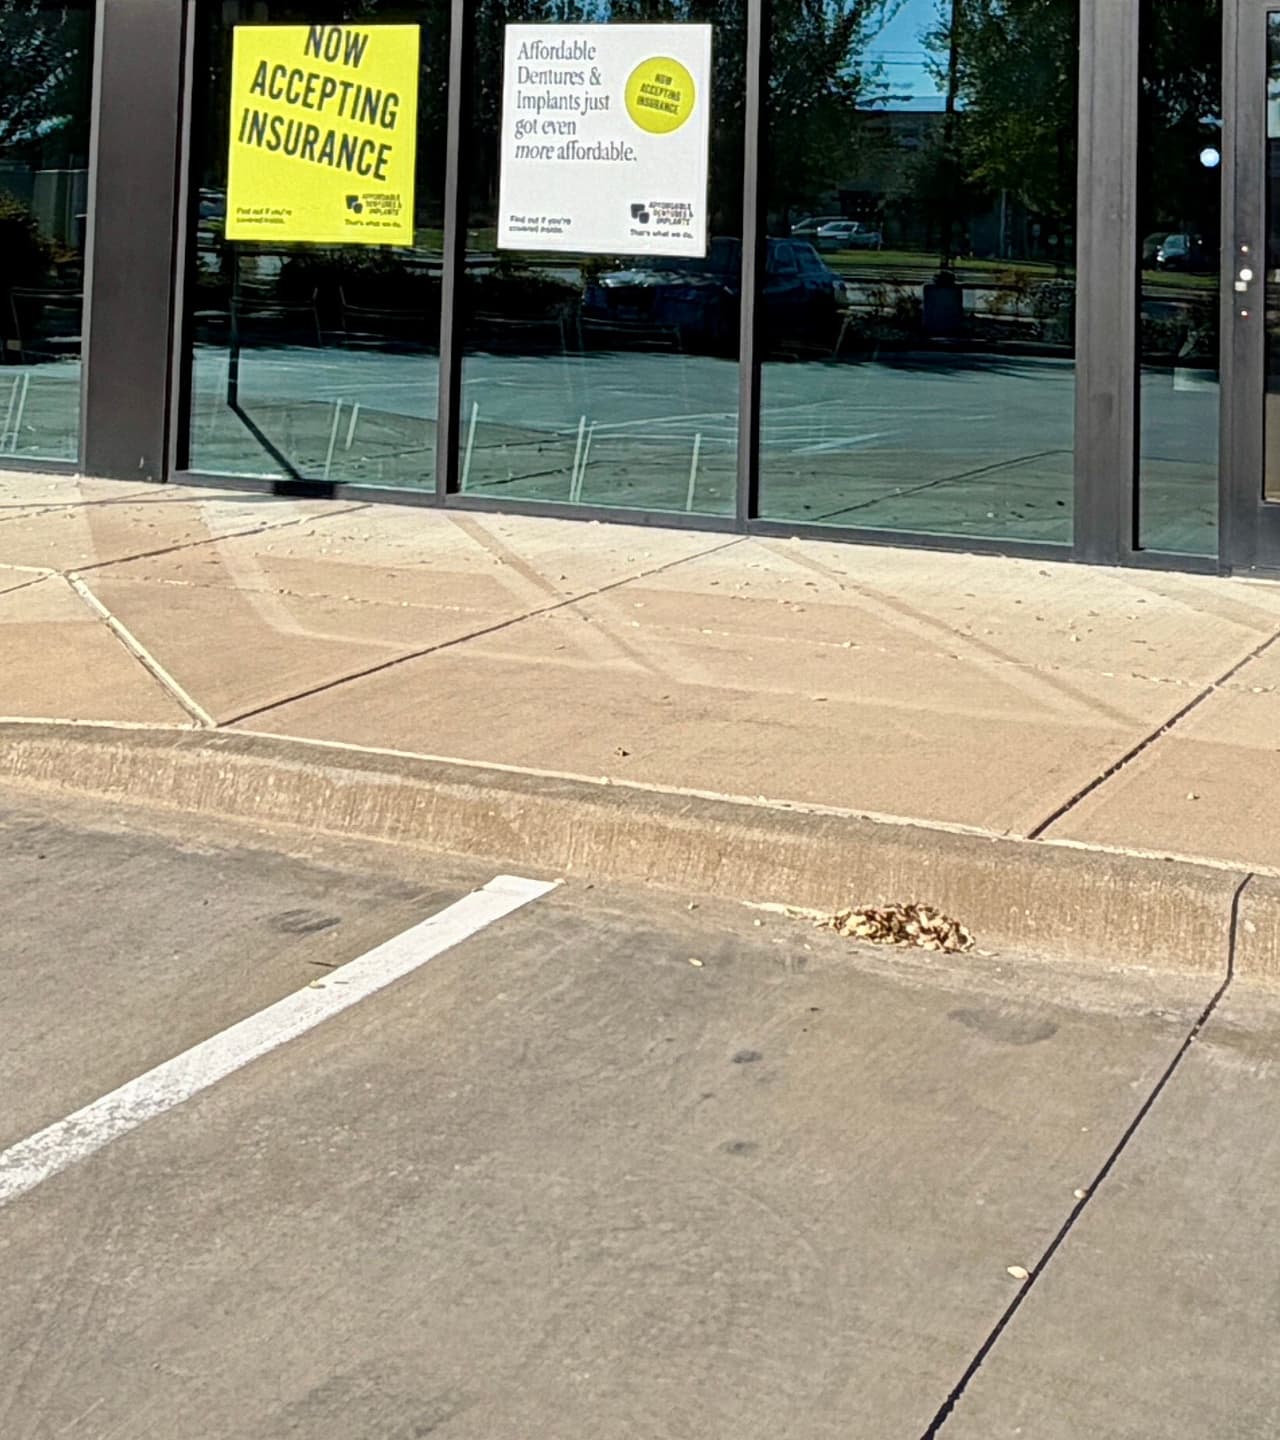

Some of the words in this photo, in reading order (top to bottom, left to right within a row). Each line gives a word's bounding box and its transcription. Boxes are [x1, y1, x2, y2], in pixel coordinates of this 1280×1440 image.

[304, 25, 368, 68] NOW
[517, 40, 596, 60] Affordable
[517, 66, 585, 86] Dentures
[589, 66, 602, 86] &
[655, 73, 672, 86] NOW
[250, 60, 399, 130] ACCEPTING
[517, 90, 580, 115] Implants
[580, 94, 610, 116] just
[640, 83, 681, 102] ACCEPTING
[636, 95, 680, 115] INSURANCE
[514, 118, 538, 139] got
[542, 121, 577, 135] even
[238, 108, 392, 181] INSURANCE
[515, 143, 555, 160] more
[557, 140, 637, 161] affordable.
